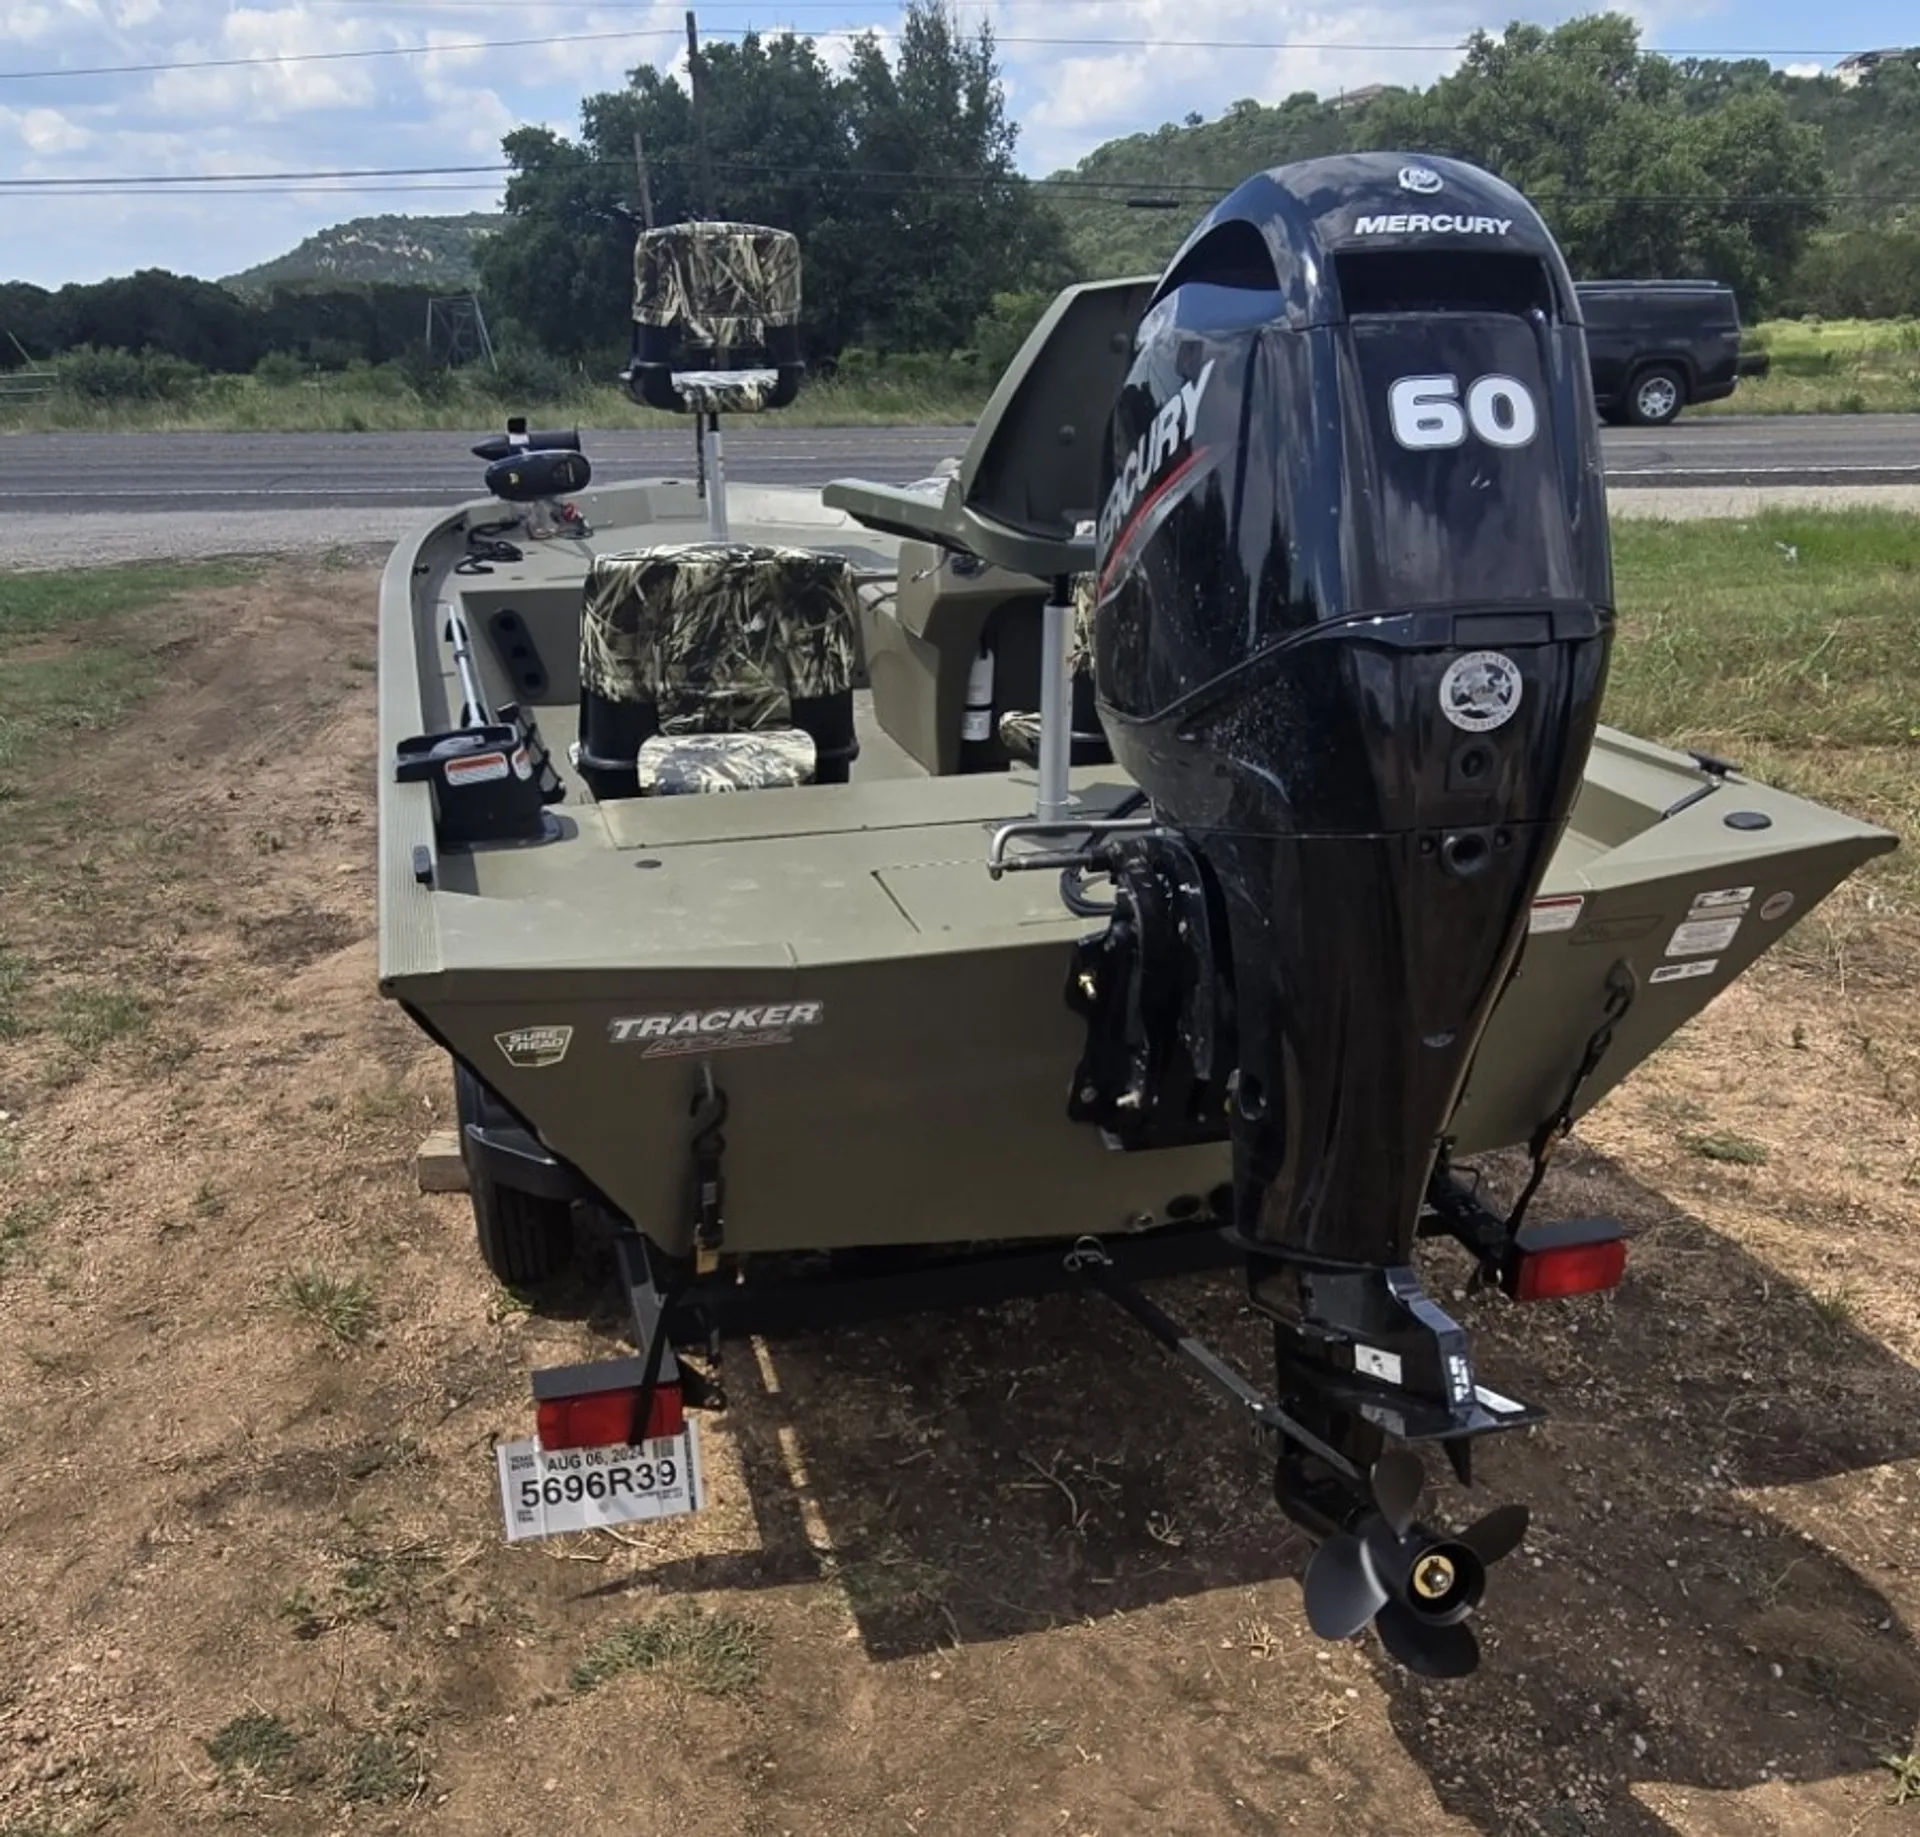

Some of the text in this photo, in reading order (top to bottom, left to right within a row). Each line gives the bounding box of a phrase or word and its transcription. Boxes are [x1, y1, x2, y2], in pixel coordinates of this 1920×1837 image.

[1354, 213, 1513, 236] MERCURY
[1388, 374, 1538, 450] 60
[1099, 358, 1216, 556] ERCURY
[613, 1002, 821, 1040] TRACKER
[504, 1038, 564, 1052] TREAD
[547, 1453, 582, 1472] AUG
[521, 1459, 677, 1508] 5696R39
